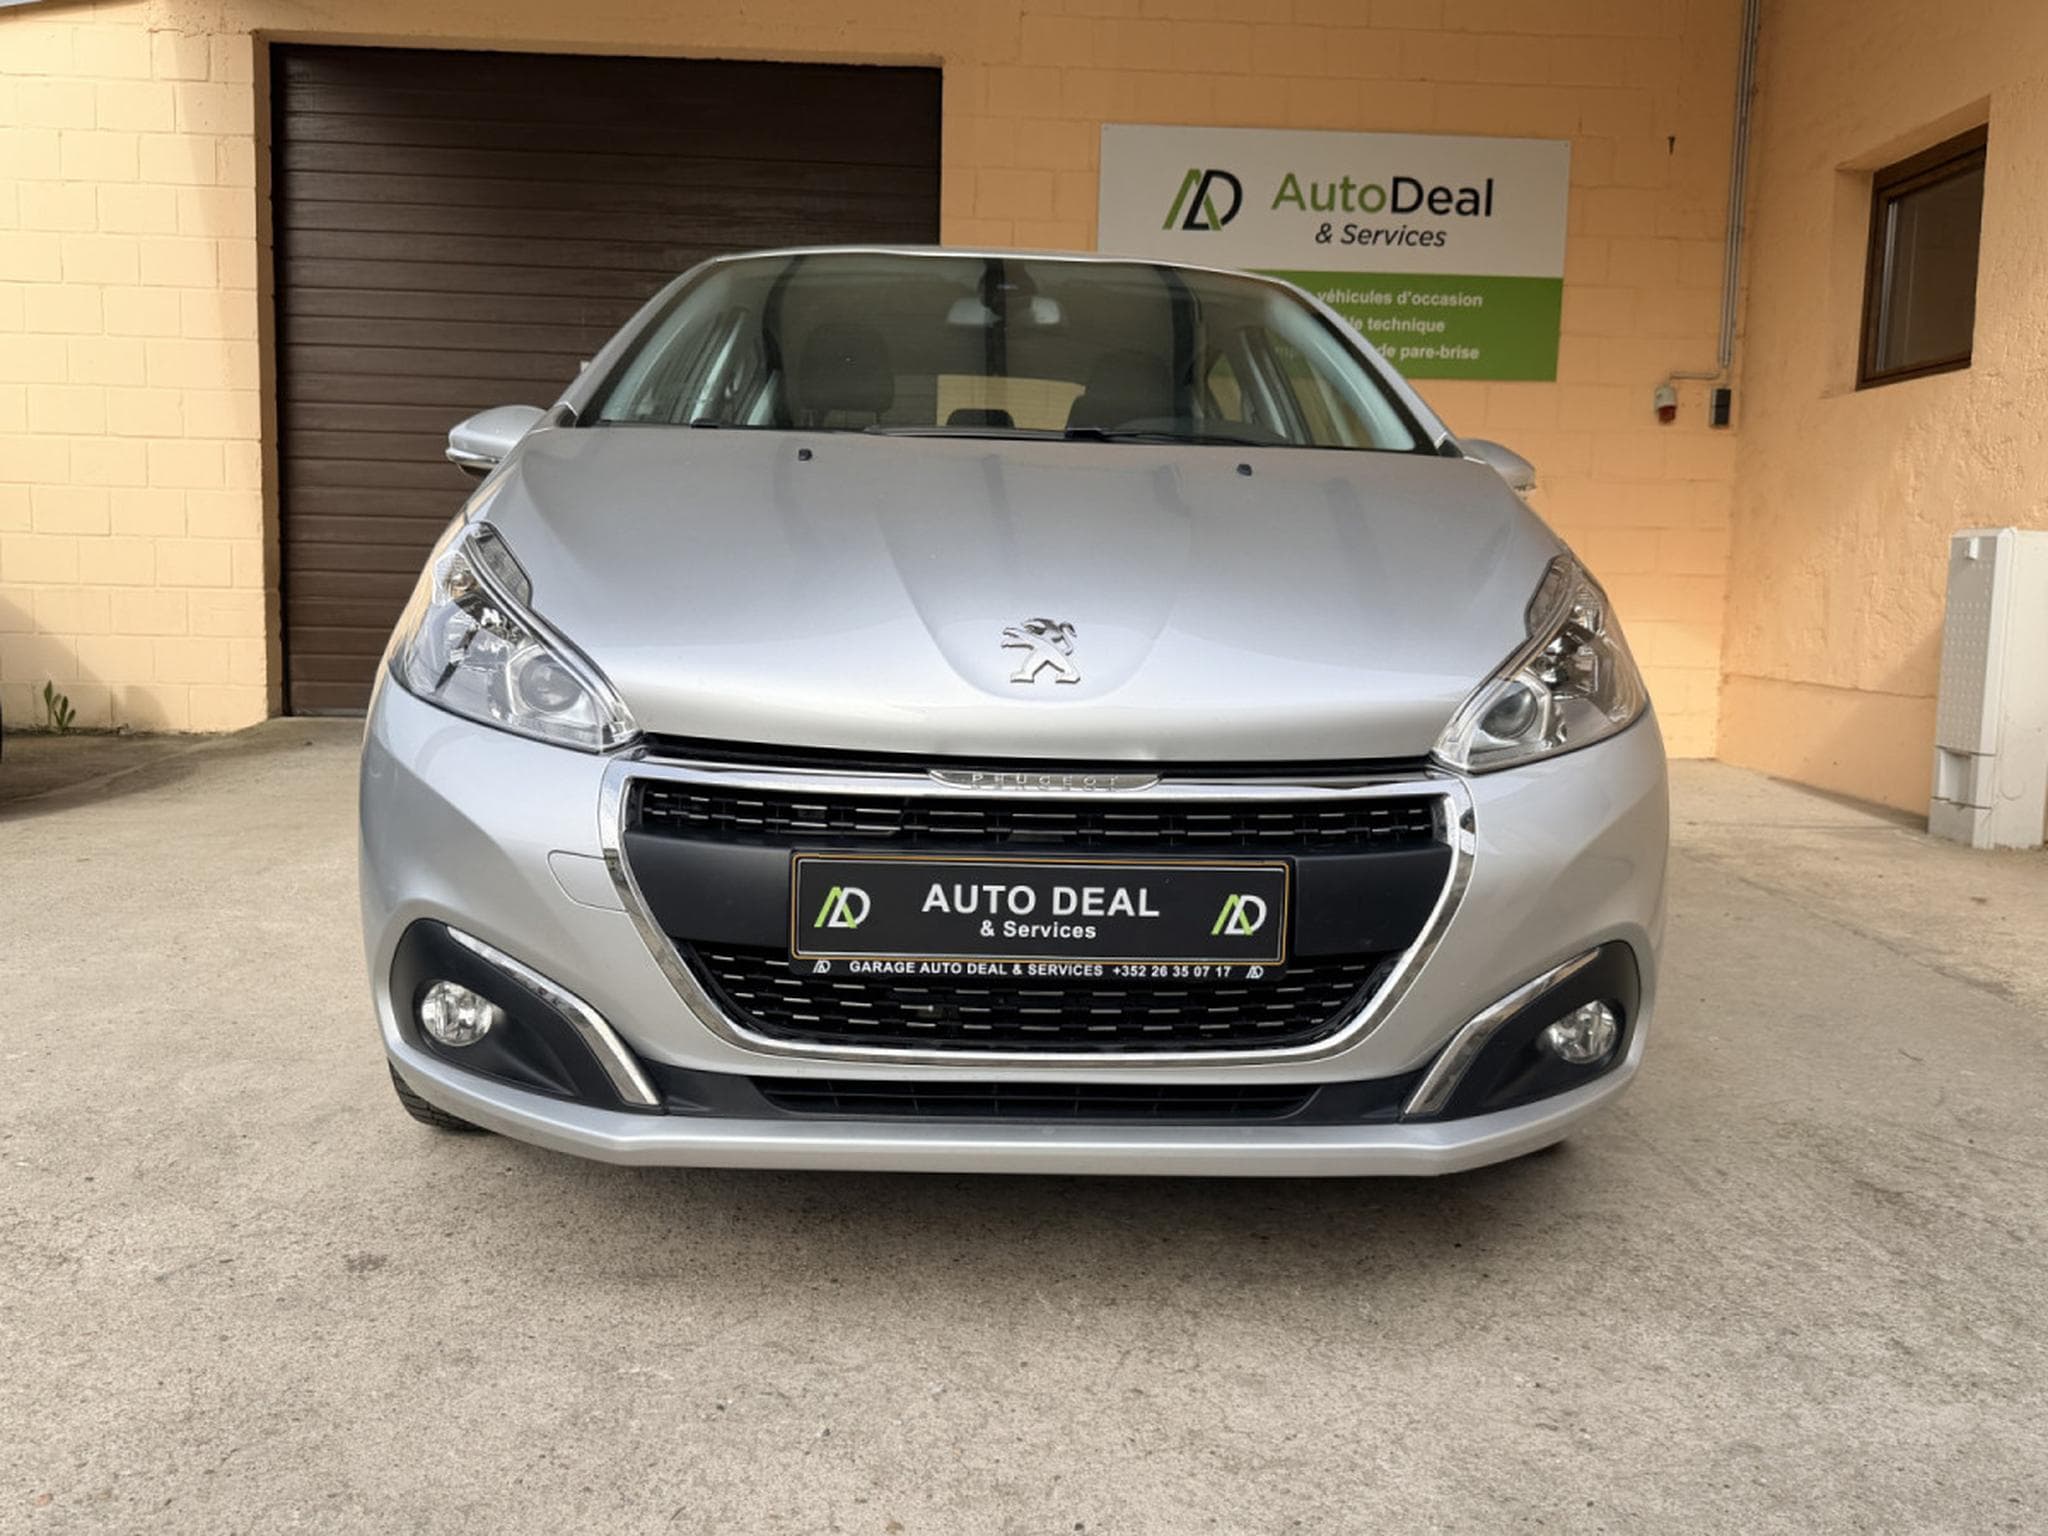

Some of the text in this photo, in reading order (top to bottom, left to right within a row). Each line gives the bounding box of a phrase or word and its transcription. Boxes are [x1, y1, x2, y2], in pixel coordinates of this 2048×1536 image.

[1271, 172, 1494, 217] AutoDeal
[1315, 222, 1447, 248] & Services
[1317, 290, 1483, 307] véhicules d'occasion
[1368, 317, 1446, 335] technique
[1401, 346, 1479, 361] pare-brise
[921, 883, 1161, 917] AUTO DEAL
[979, 919, 1098, 940] & Services
[849, 961, 1232, 979] GARAGE AUTO DEAL & SERVICES +352 26 35 07 17
